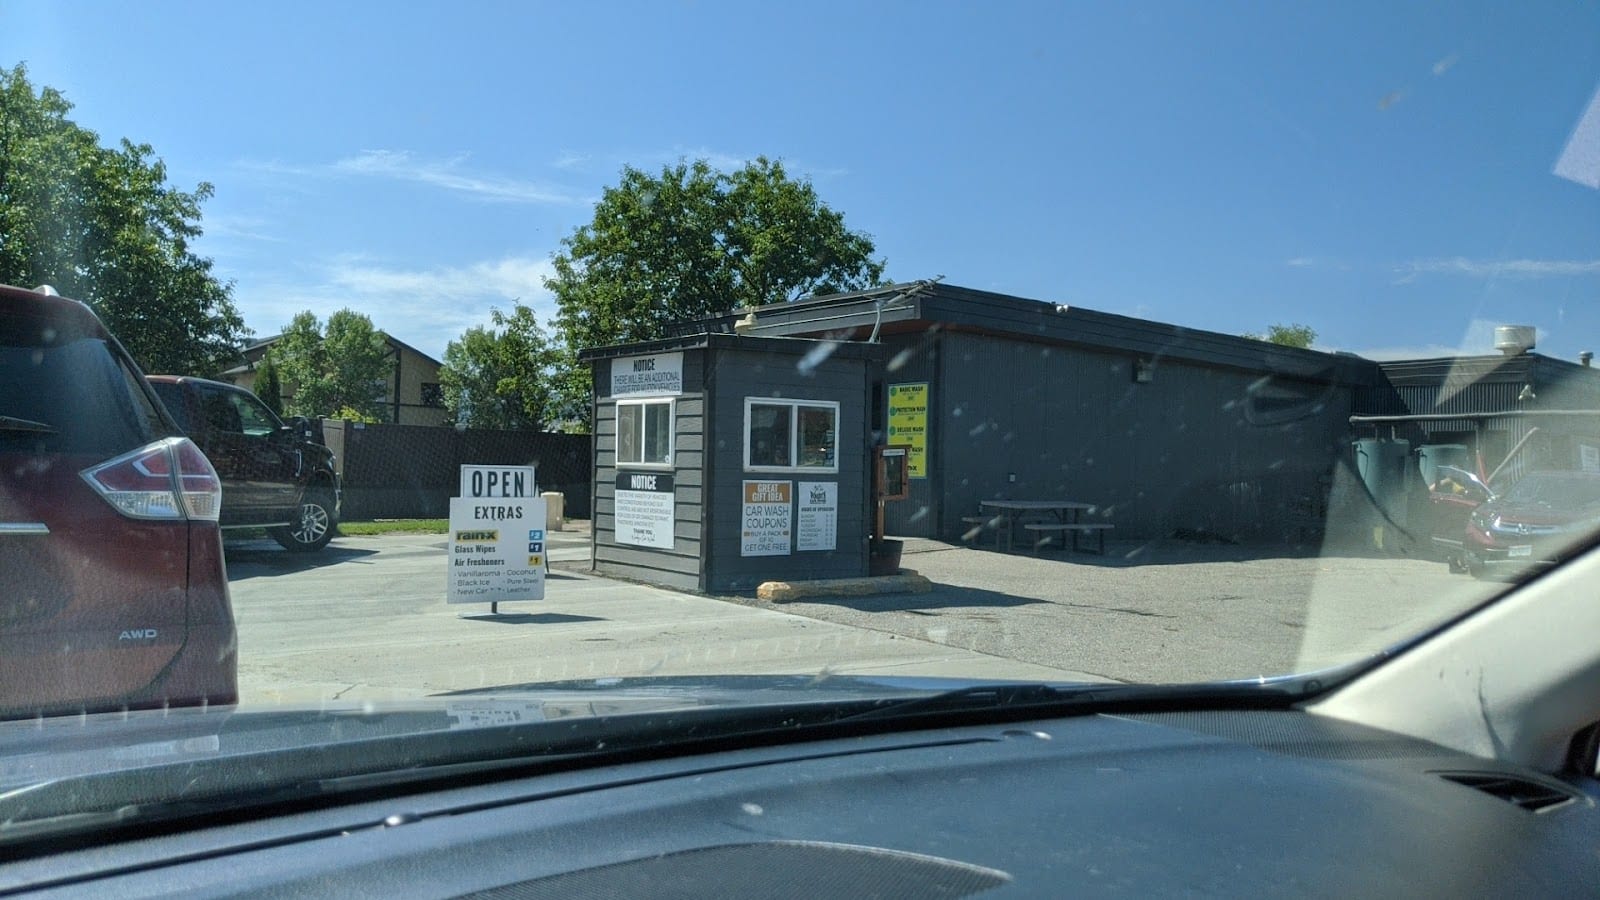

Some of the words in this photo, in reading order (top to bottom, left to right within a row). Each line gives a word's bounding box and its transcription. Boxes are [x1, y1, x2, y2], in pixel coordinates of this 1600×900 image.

[634, 358, 656, 372] NOTICE
[652, 372, 680, 382] ADDITIONAL
[472, 471, 524, 497] OPEN
[631, 475, 656, 490] NOTICE
[758, 484, 778, 492] GREAT
[752, 493, 766, 502] GIFT
[768, 493, 783, 501] IDEA
[474, 506, 523, 520] EXTRAS
[746, 506, 762, 516] CAR
[765, 506, 789, 516] WASH
[746, 519, 787, 528] COUPONS
[476, 545, 496, 554] Wipes
[467, 558, 504, 566] Fresheners
[119, 629, 157, 640] AWD
